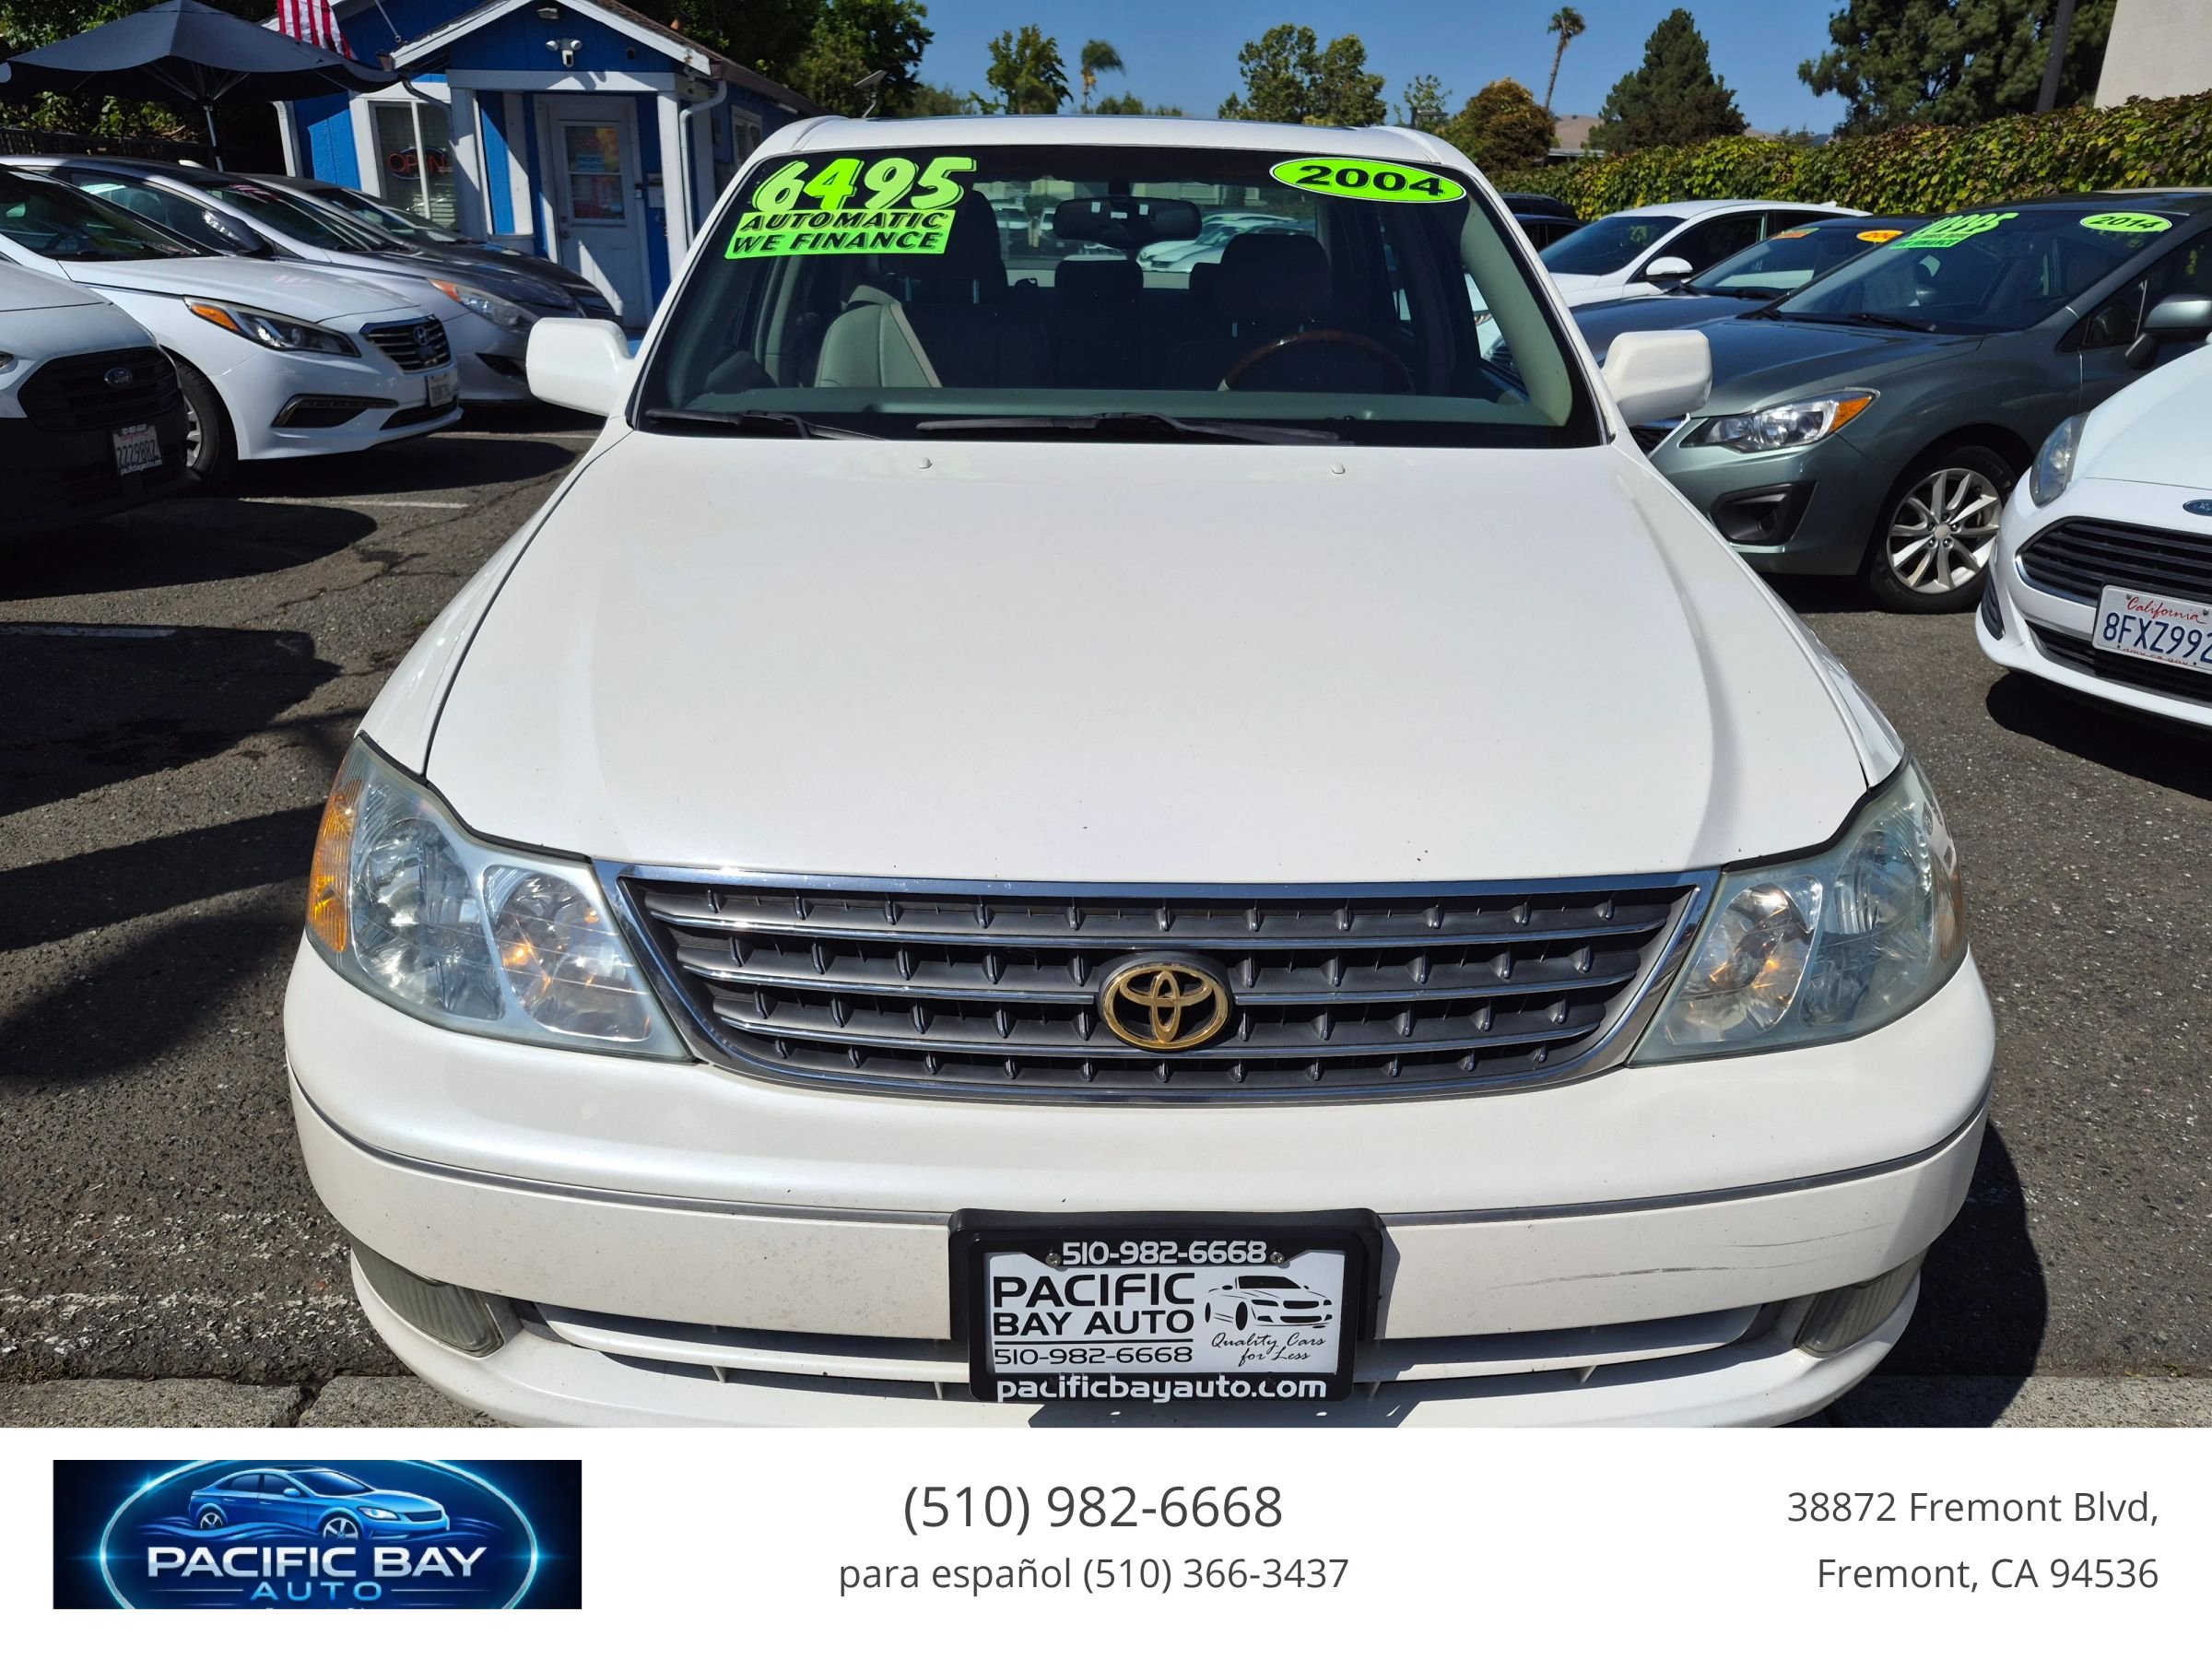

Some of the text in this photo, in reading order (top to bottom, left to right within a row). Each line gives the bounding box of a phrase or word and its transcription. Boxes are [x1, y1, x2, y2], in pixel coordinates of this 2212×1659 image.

[387, 152, 445, 175] OPN
[752, 157, 977, 211] 6495
[1296, 164, 1446, 197] 2004
[740, 211, 949, 230] AUTOMATIC
[2088, 216, 2163, 229] 2014
[733, 231, 945, 254] WE FINANCE
[2126, 596, 2208, 625] California
[1062, 1240, 1267, 1265] 510-982-6668
[993, 1272, 1195, 1308] PACIFIC
[993, 1310, 1194, 1336] BAY AUTO
[1210, 1332, 1327, 1352] Quality Cars
[994, 1347, 1194, 1366] 510-982-6668
[1240, 1347, 1311, 1367] for Less
[997, 1374, 1327, 1404] pacificbayauto.com
